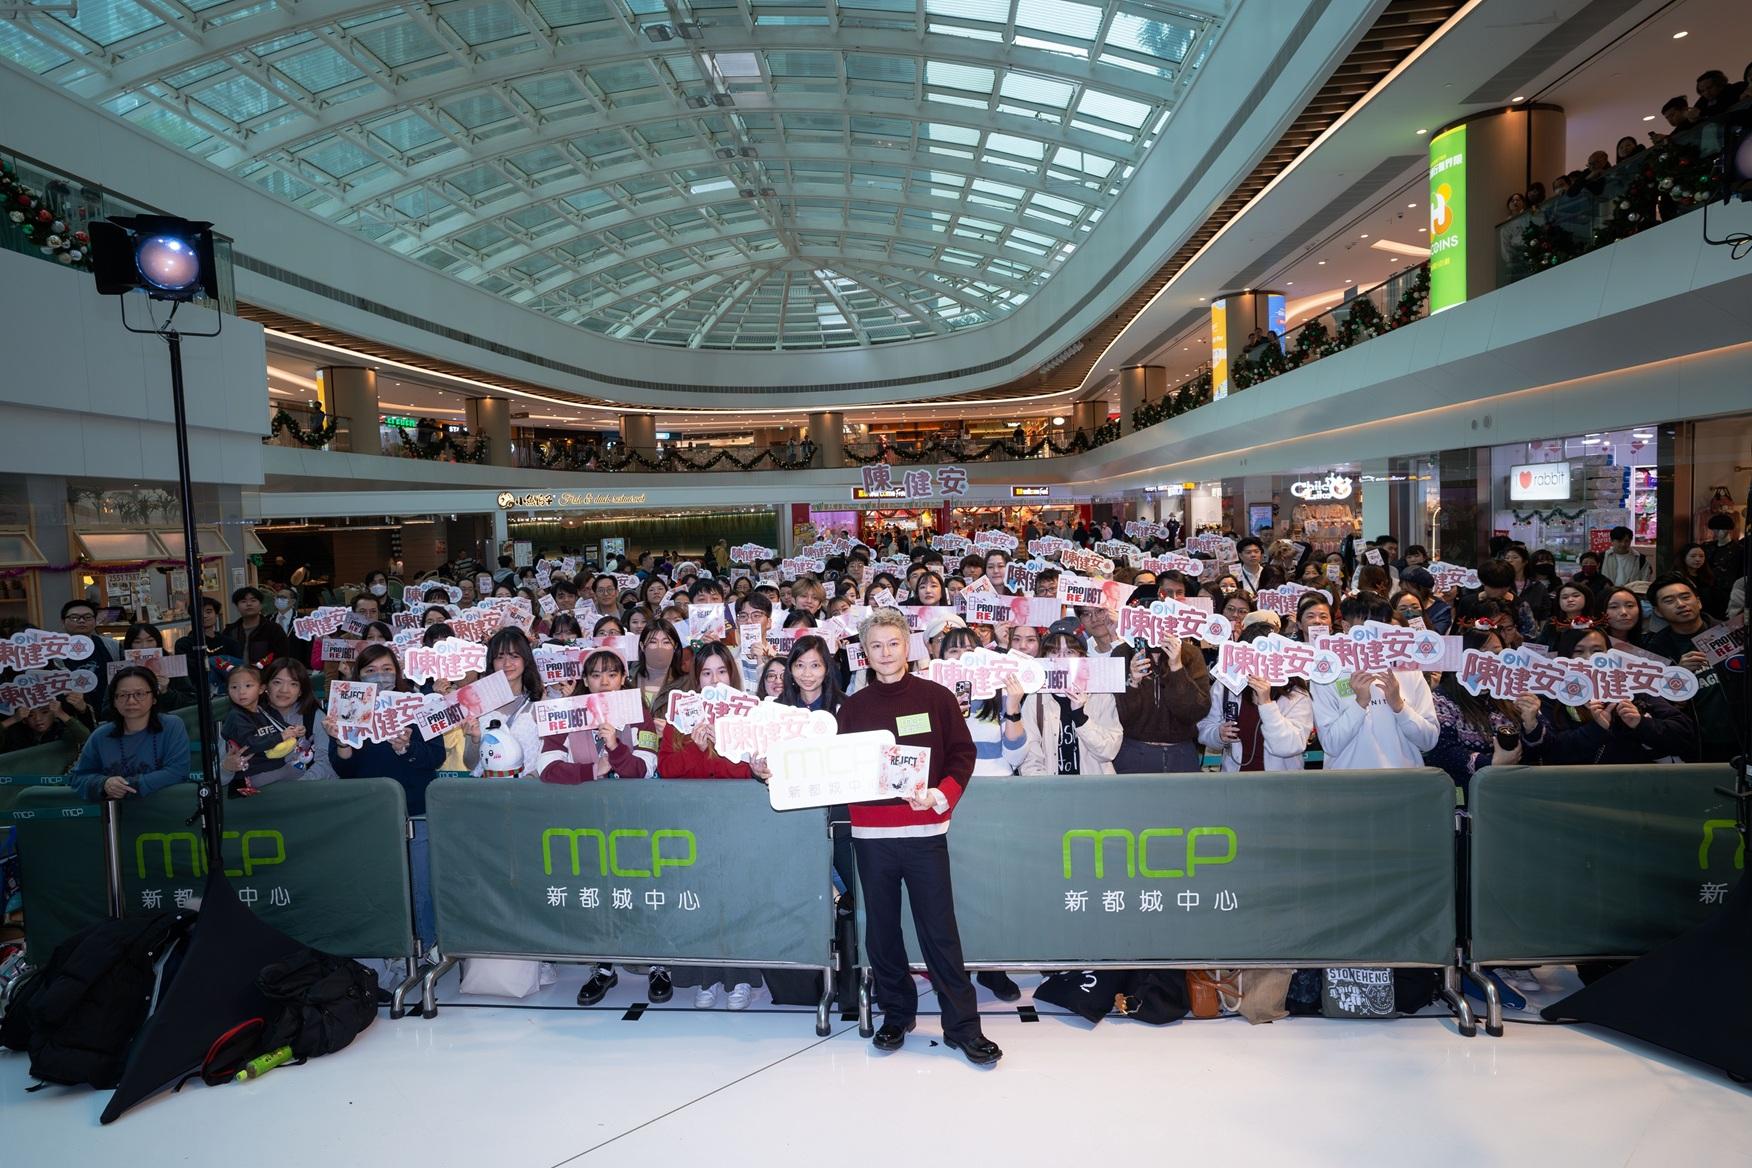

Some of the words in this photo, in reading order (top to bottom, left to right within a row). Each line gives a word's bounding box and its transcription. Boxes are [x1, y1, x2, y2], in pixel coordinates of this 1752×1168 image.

[863, 464, 966, 498] 陳健安
[1534, 471, 1565, 487] rabbit
[1062, 549, 1105, 572] 陳健安
[1431, 563, 1447, 574] ON
[1280, 586, 1296, 595] ON
[1153, 602, 1176, 616] ON
[294, 608, 347, 638] 陳健安
[1120, 607, 1207, 648] 陳健安
[1354, 628, 1379, 641] ON
[1257, 640, 1281, 651] ON
[1318, 631, 1416, 672] 陳健安
[408, 645, 485, 681] 陳健安
[1222, 645, 1316, 685] 陳健安
[1503, 654, 1531, 667] ON
[1594, 654, 1623, 668] ON
[935, 658, 1018, 699] 陳健安
[1463, 652, 1566, 698] 陳健安
[703, 689, 728, 700] ON
[890, 755, 918, 769] REJECT
[141, 886, 291, 909] 新都中心
[546, 885, 701, 911] 新都城中心
[1064, 889, 1239, 913] 新都城中心
